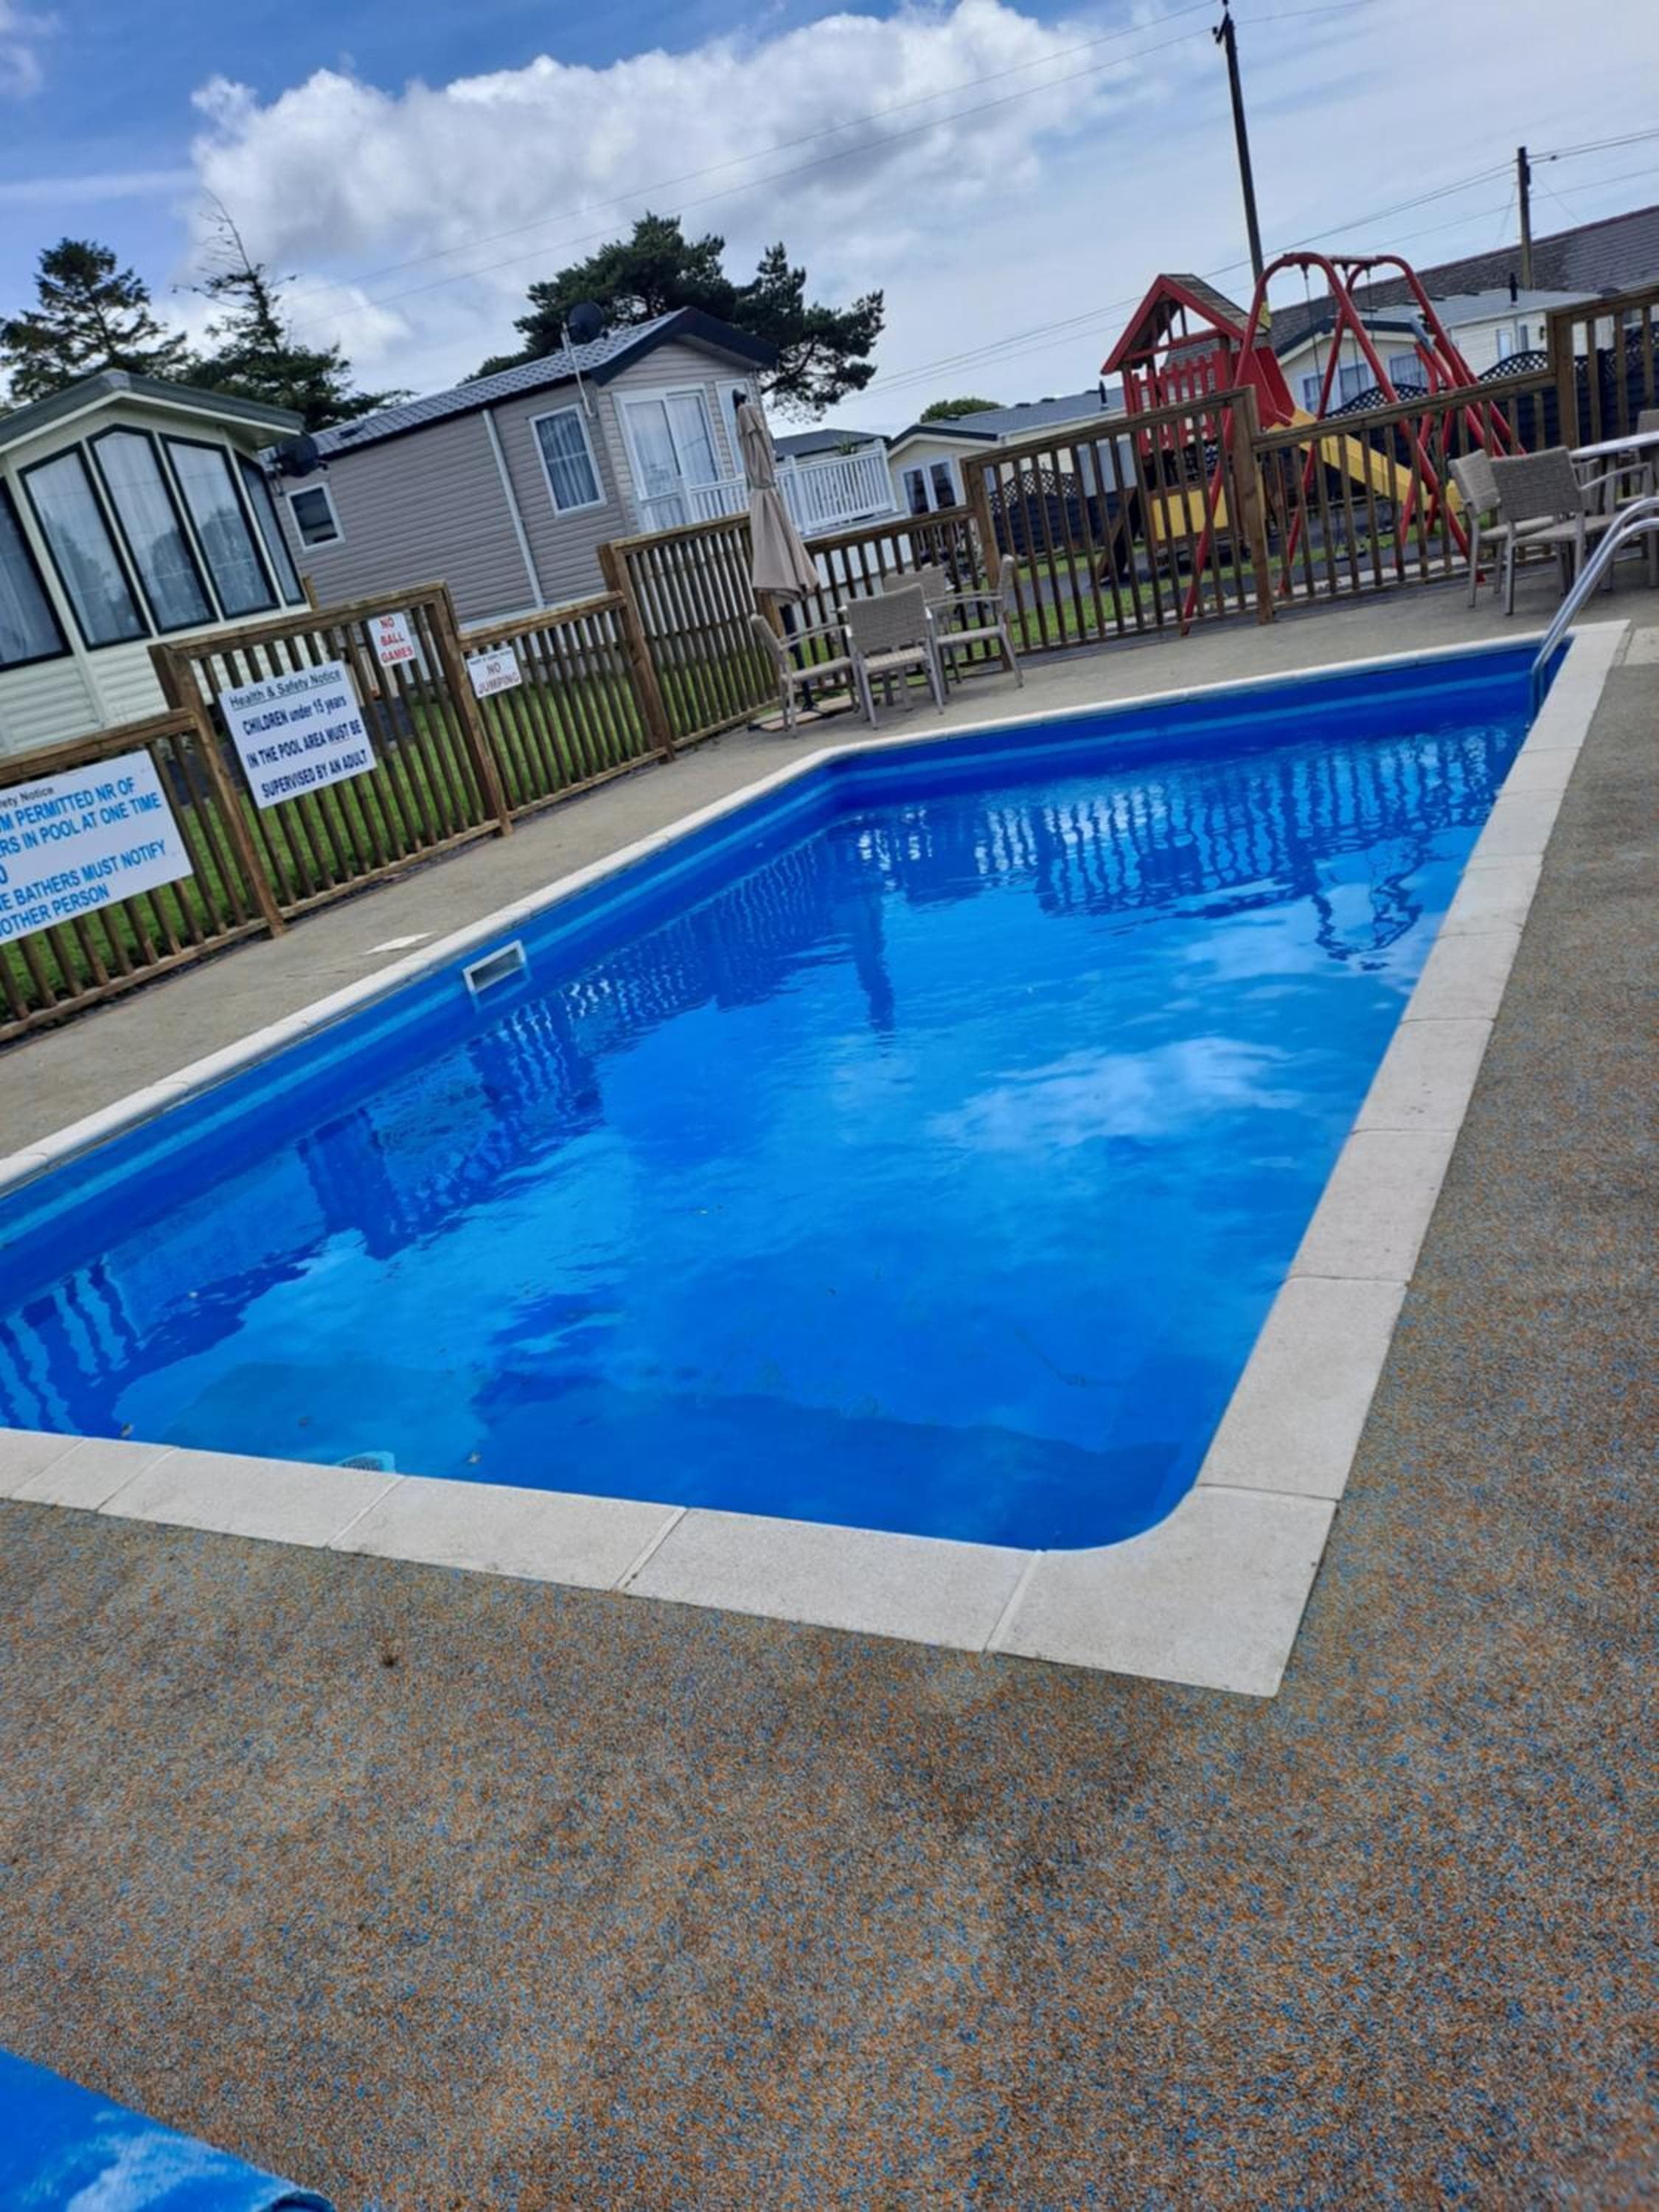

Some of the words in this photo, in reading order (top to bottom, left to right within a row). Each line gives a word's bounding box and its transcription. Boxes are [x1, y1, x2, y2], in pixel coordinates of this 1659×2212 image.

[380, 616, 394, 627] NO
[380, 632, 405, 647] BALL
[380, 646, 413, 662] GAMES
[487, 662, 501, 675] NO
[229, 689, 265, 709] Health
[267, 686, 275, 698] &
[276, 678, 308, 695] Safety
[310, 669, 342, 684] Notice
[478, 672, 519, 695] JUMPING
[243, 709, 288, 735] CHILDREN
[289, 704, 313, 722] under
[313, 698, 324, 714] 15
[324, 695, 347, 714] years
[246, 752, 259, 769] IN
[259, 746, 279, 765] THE
[278, 740, 304, 759] POOL
[303, 731, 327, 750] AREA
[325, 723, 349, 741] MUST
[349, 719, 362, 735] BE
[20, 786, 55, 801] Notice
[261, 767, 316, 799] SUPERVISED
[315, 763, 329, 779] BY
[329, 759, 342, 774] AN
[342, 749, 367, 769] ADULT
[15, 790, 94, 827] PERMITTED
[95, 783, 117, 803] NR
[118, 776, 136, 795] OF
[23, 830, 38, 849] IN
[40, 818, 80, 844] POOL
[82, 812, 97, 831] AT
[100, 802, 130, 825] ONE
[130, 791, 161, 815] TIME
[13, 870, 81, 906] BATHERS
[81, 856, 119, 881] MUST
[121, 839, 166, 869] NOTIFY
[0, 905, 52, 936] OTHER
[52, 883, 110, 916] PERSON
